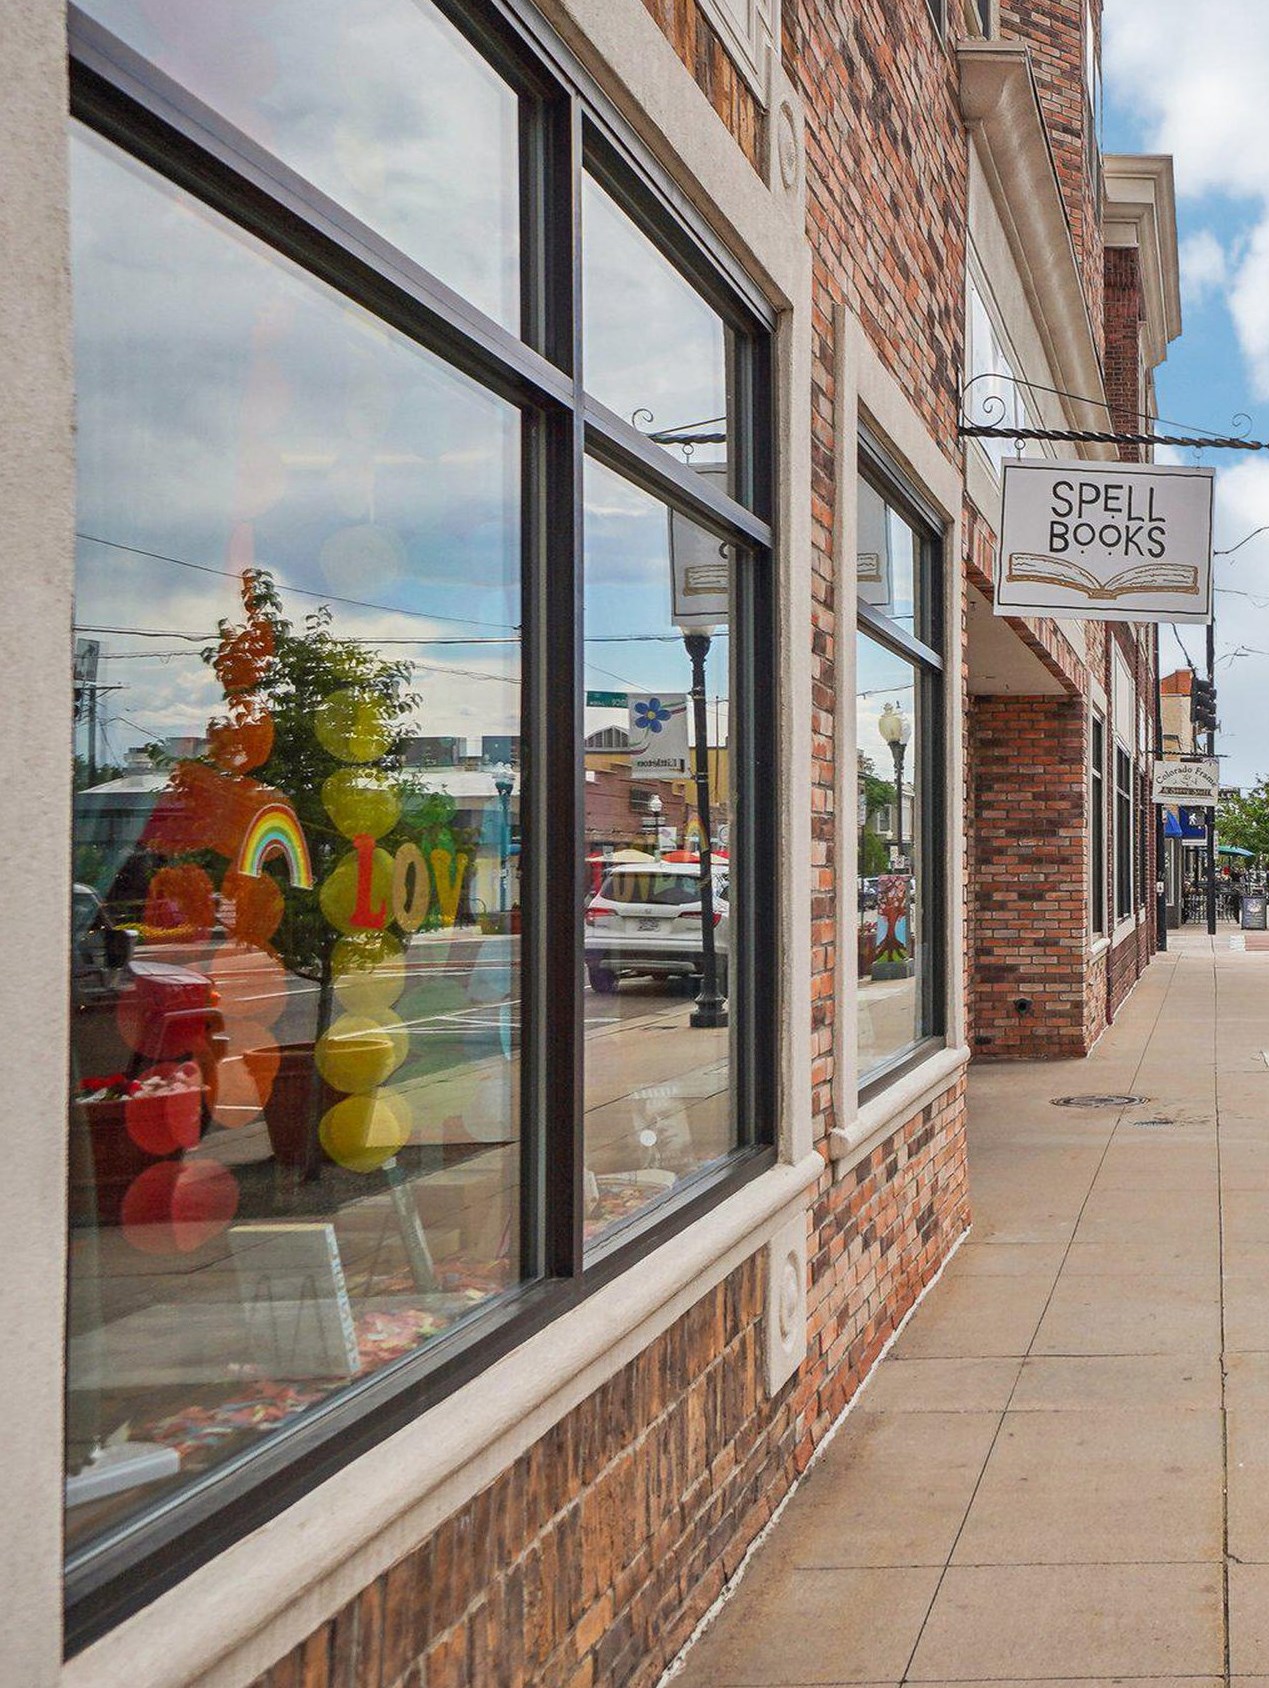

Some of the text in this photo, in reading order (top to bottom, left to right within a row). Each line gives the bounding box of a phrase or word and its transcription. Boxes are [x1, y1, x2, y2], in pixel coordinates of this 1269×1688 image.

[1051, 481, 1166, 523] SPELL
[1050, 520, 1166, 558] BOOKS
[1156, 765, 1193, 784] Colorado
